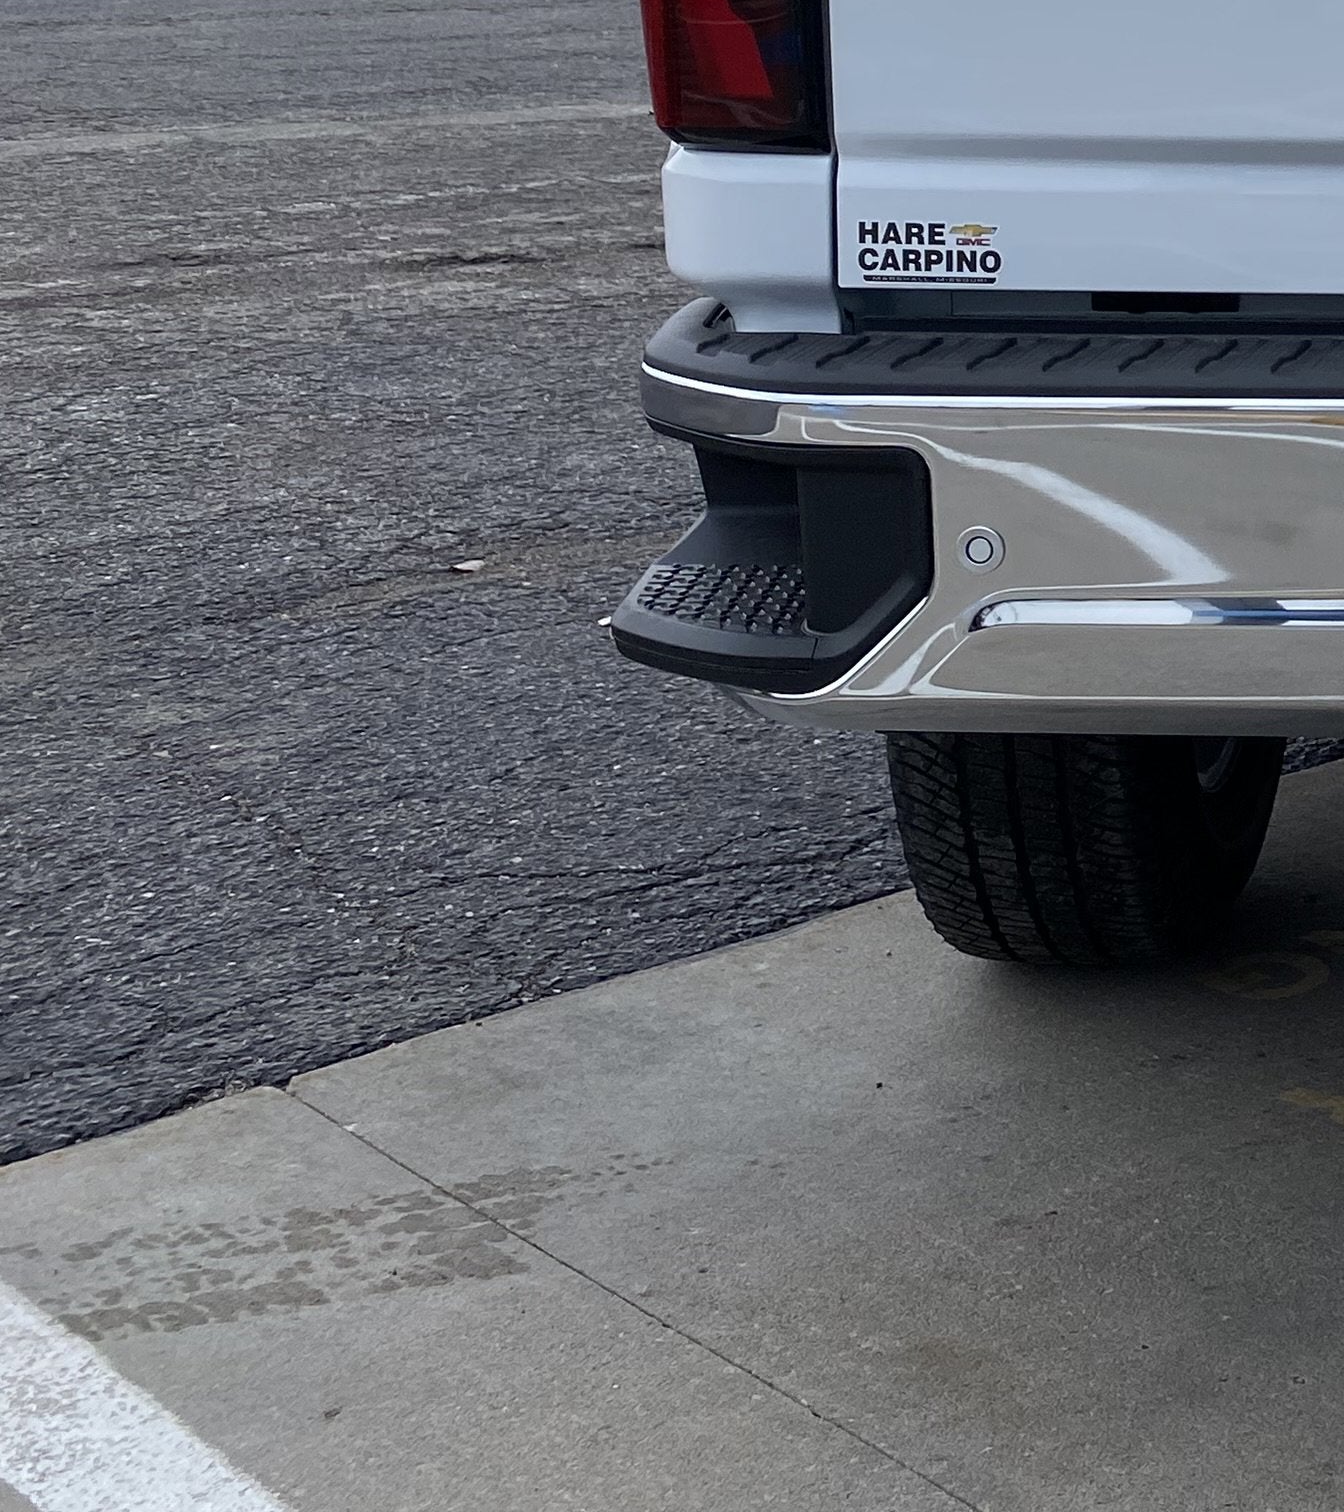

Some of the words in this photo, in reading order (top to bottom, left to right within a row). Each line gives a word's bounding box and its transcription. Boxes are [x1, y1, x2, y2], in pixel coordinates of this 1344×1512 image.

[857, 221, 946, 246] HARE
[956, 237, 992, 247] GMC
[857, 247, 1003, 274] CARPINO
